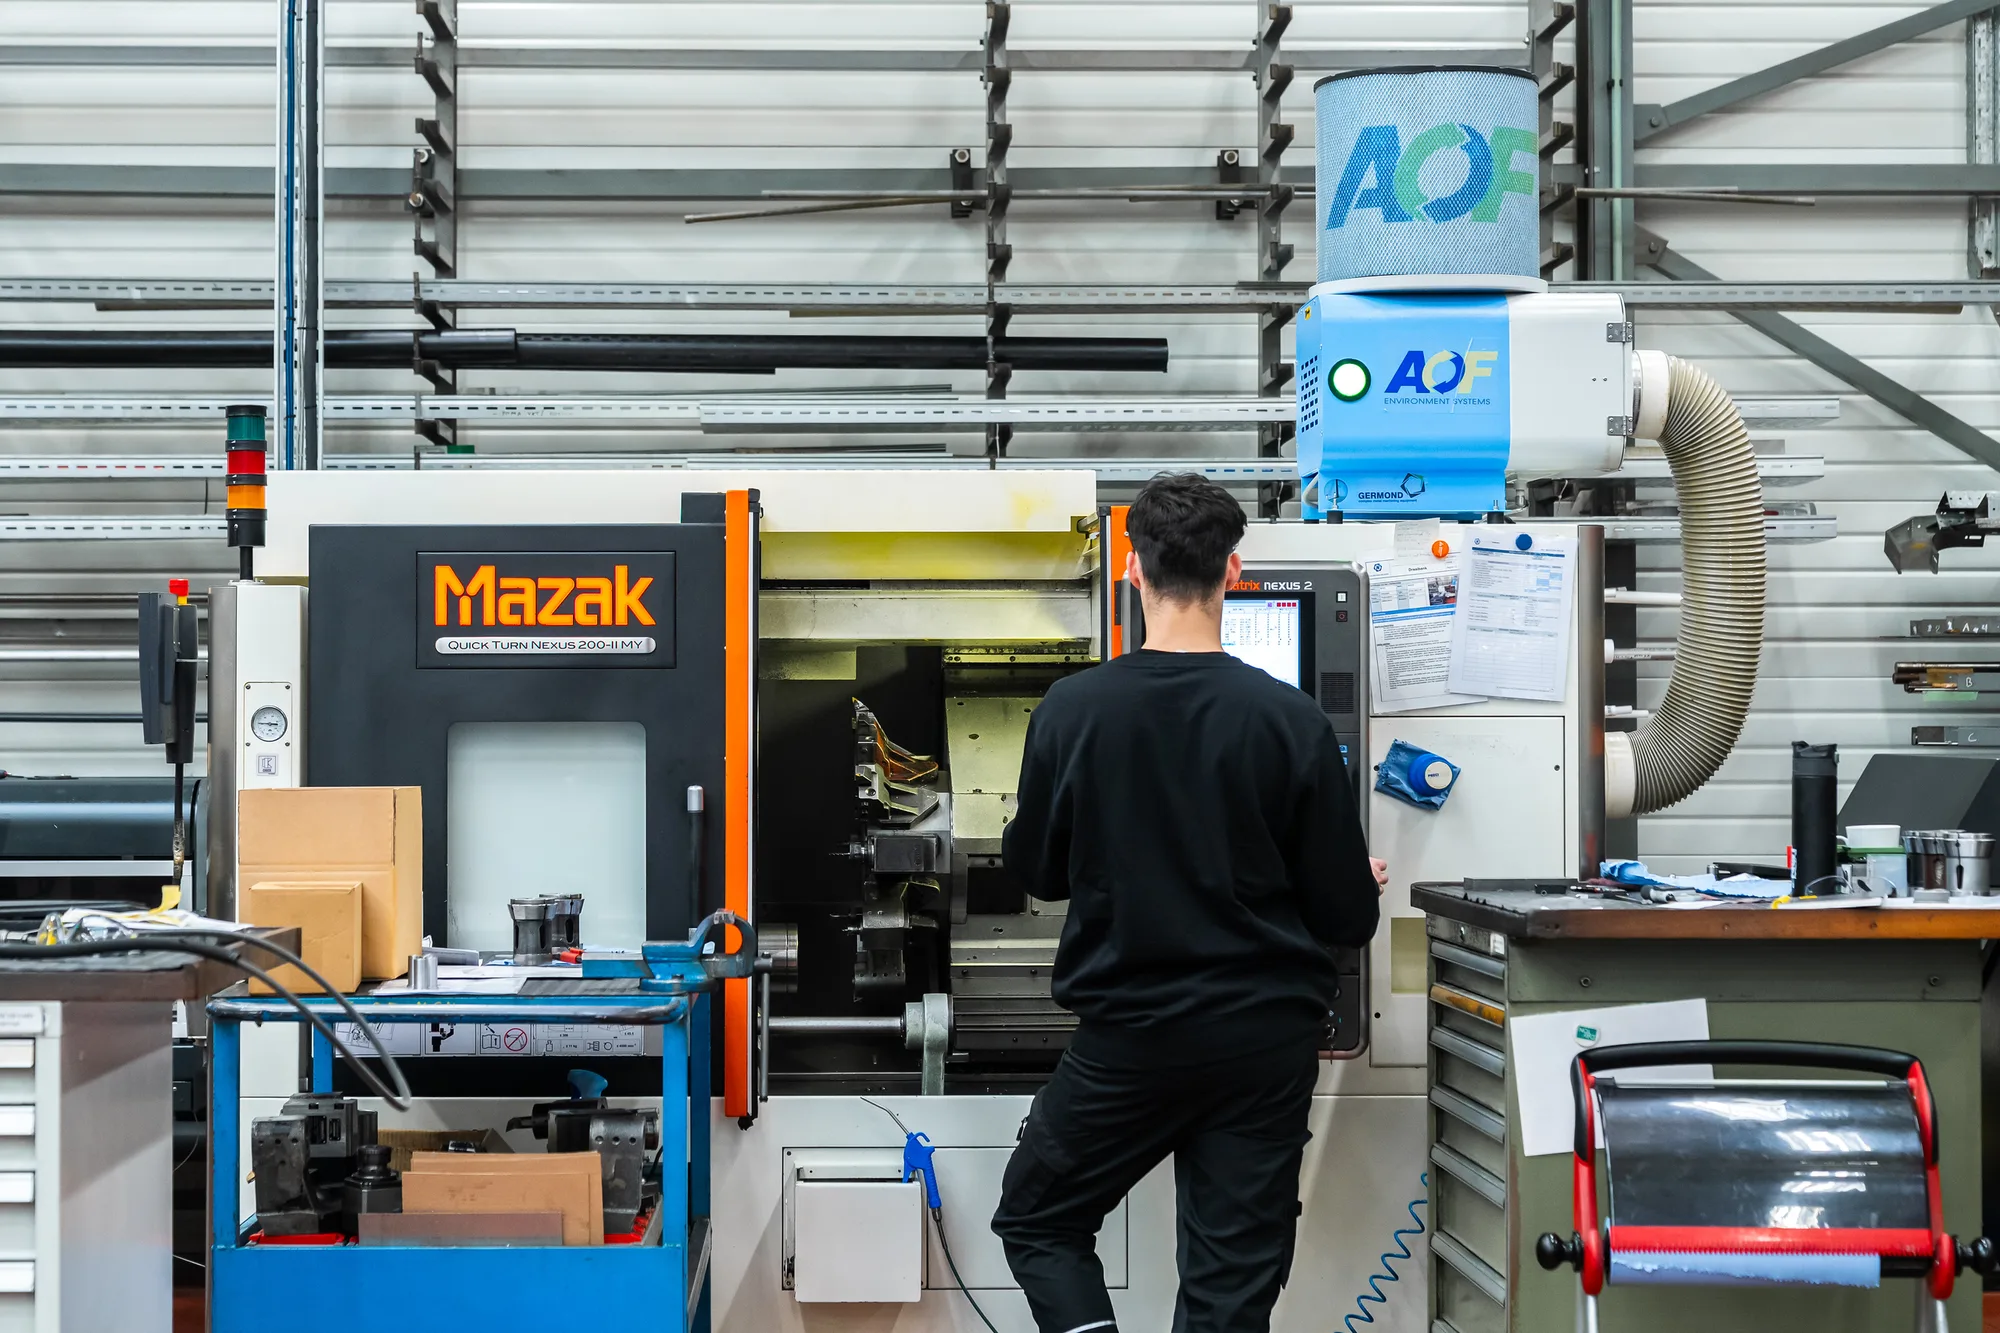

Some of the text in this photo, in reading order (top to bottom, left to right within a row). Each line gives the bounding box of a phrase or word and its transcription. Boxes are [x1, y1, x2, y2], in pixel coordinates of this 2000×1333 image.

[1325, 121, 1539, 230] AOF
[1383, 349, 1498, 394] AOF
[1384, 397, 1450, 405] ENVIRONMENT
[1358, 491, 1404, 499] GERMOND
[1232, 579, 1313, 590] atrix nexus 2
[434, 564, 657, 626] Mazak
[621, 640, 643, 650] MY
[1965, 676, 1973, 688] B
